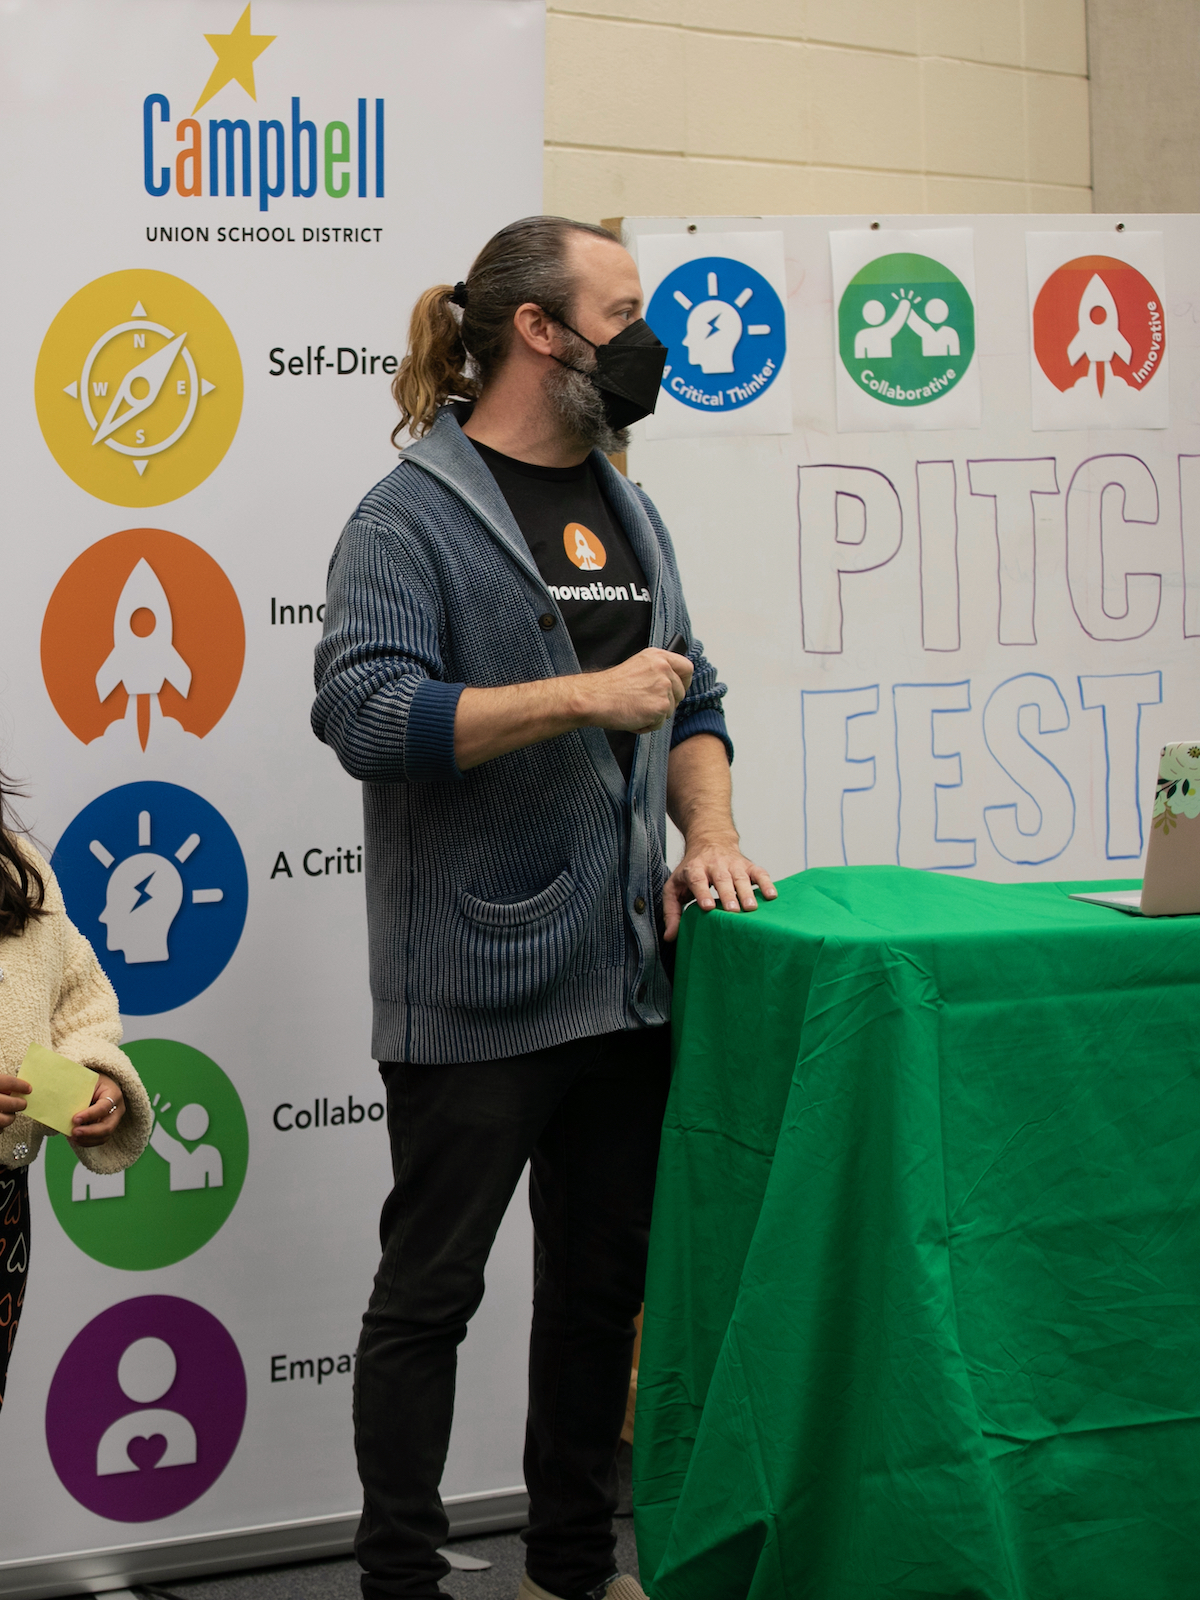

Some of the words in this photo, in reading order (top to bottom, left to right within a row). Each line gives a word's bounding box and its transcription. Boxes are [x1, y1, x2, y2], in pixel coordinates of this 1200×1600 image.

[143, 93, 385, 212] Campbell
[146, 226, 210, 243] UNION
[216, 226, 296, 243] SCHOOL
[302, 227, 383, 243] DISTRICT
[133, 333, 146, 349] N
[1131, 300, 1163, 384] Innovative
[268, 345, 399, 377] Self-Dire
[92, 381, 109, 397] W
[176, 380, 187, 396] E
[670, 376, 725, 406] Critical
[725, 358, 776, 404] Thinker
[860, 368, 957, 401] Collaborative
[135, 428, 146, 445] S
[547, 581, 629, 601] novation
[629, 582, 652, 603] La
[801, 670, 1163, 871] FEST
[269, 850, 294, 880] A
[302, 845, 362, 877] Criti
[273, 1095, 385, 1132] Collabo
[270, 1353, 356, 1385] Empa
